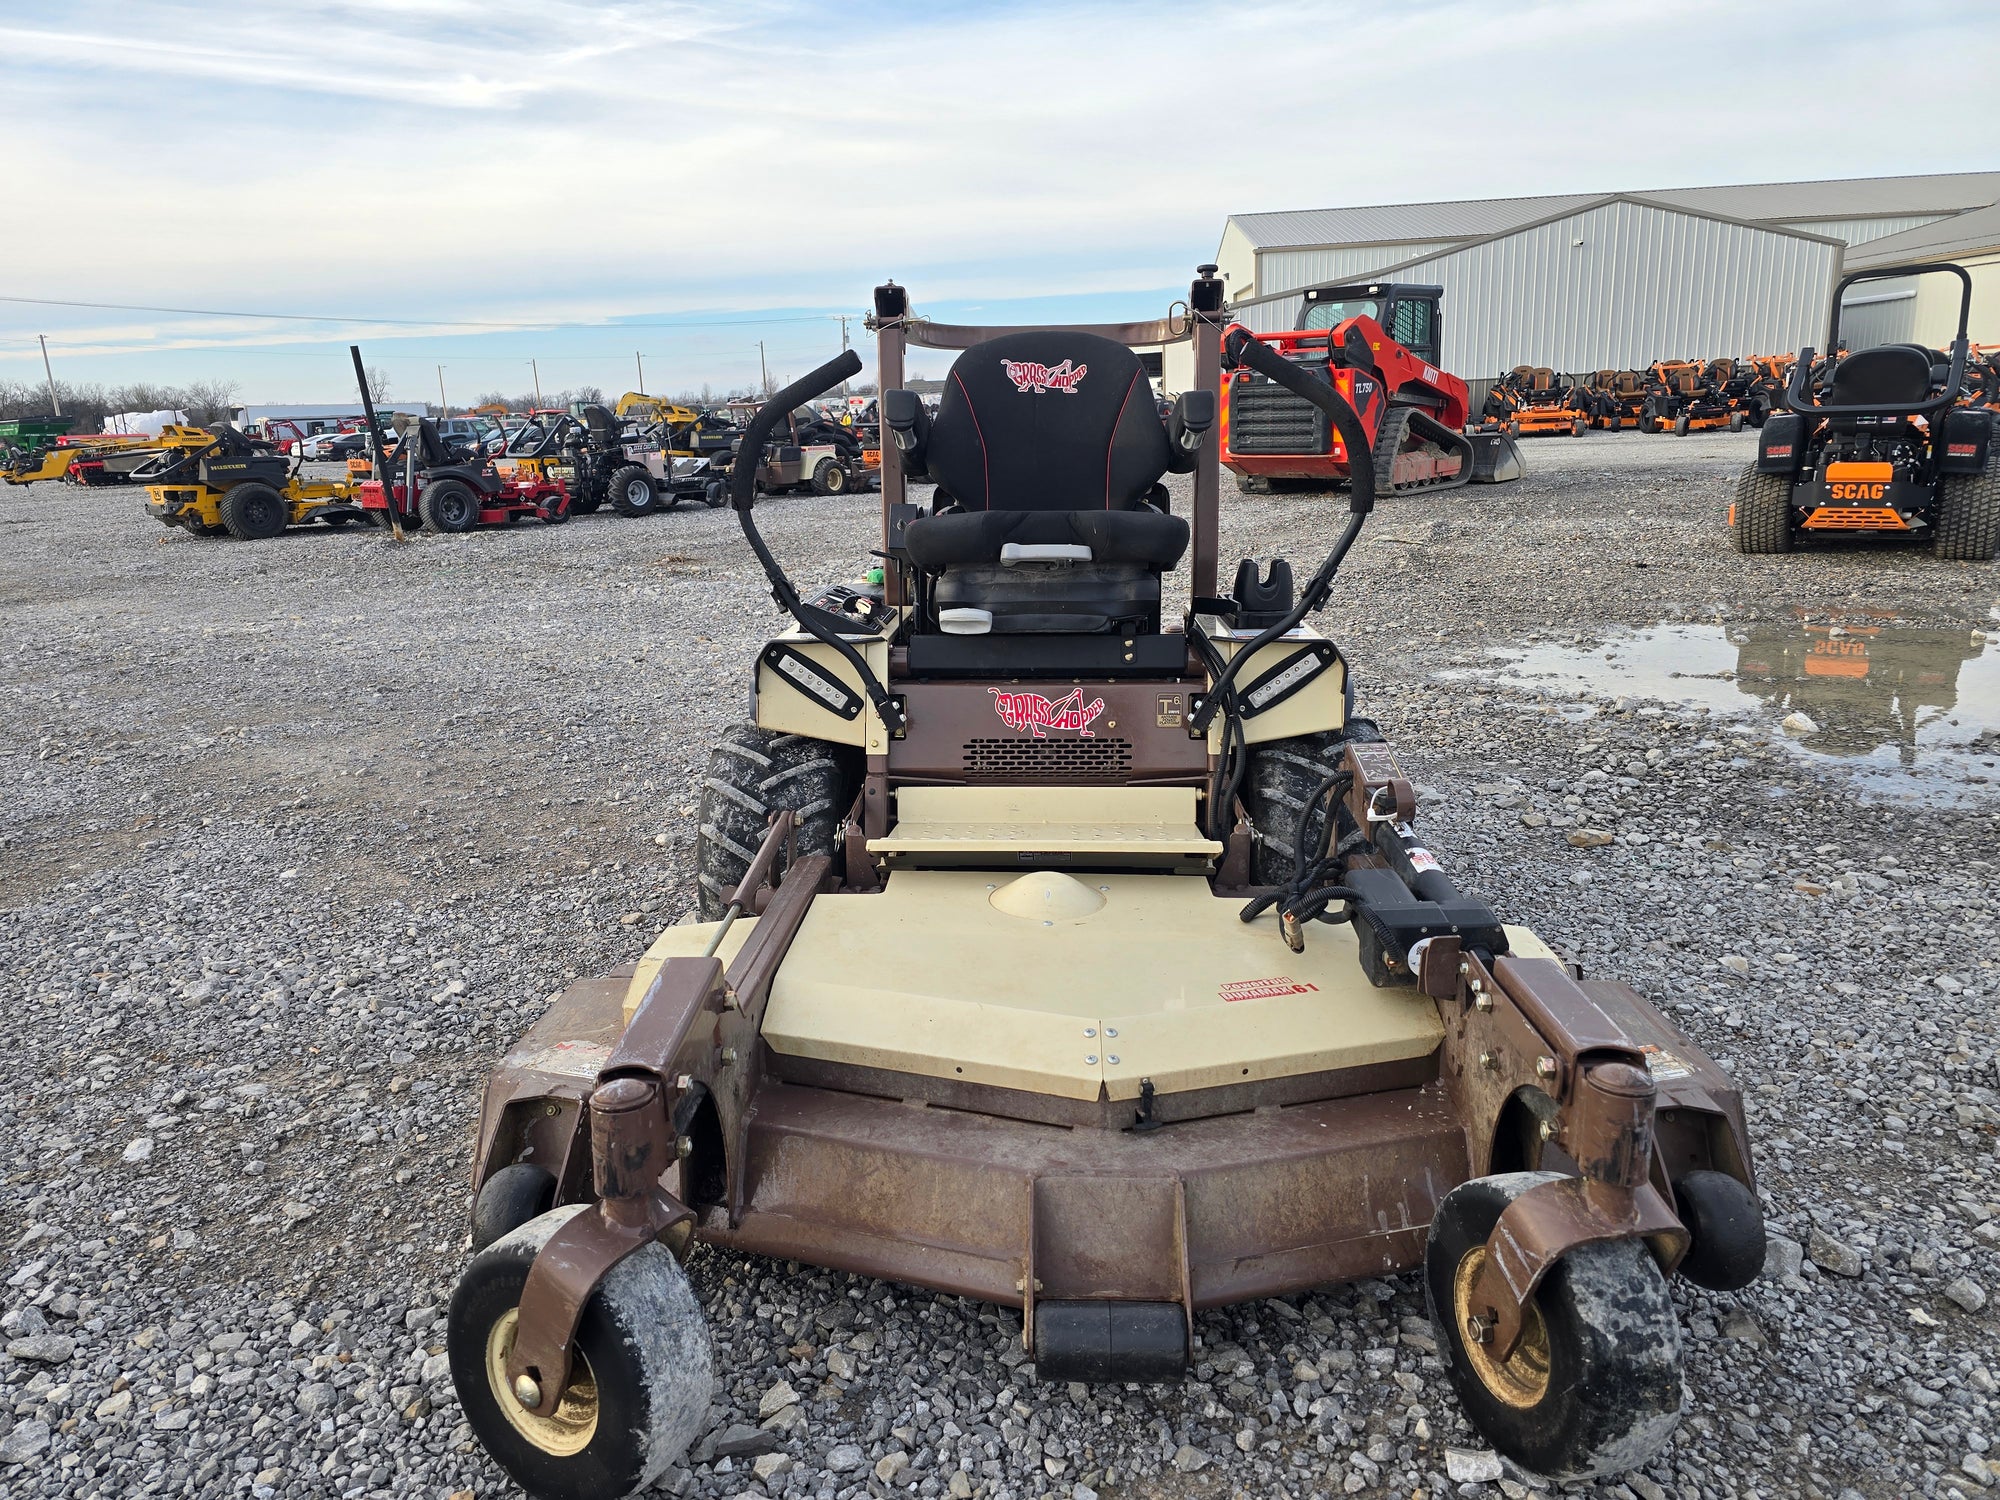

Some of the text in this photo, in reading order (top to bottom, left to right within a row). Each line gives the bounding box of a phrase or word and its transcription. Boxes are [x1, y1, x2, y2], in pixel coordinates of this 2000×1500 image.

[1355, 382, 1373, 394] TL750
[1766, 444, 1793, 455] SCAG
[1948, 444, 1977, 454] SCAG
[210, 463, 247, 471] HUSTLER
[1831, 484, 1884, 499] SCAG
[992, 689, 1105, 737] GRASSHOPPER
[1219, 986, 1294, 1001] DURAMAX
[1292, 983, 1320, 993] 61
